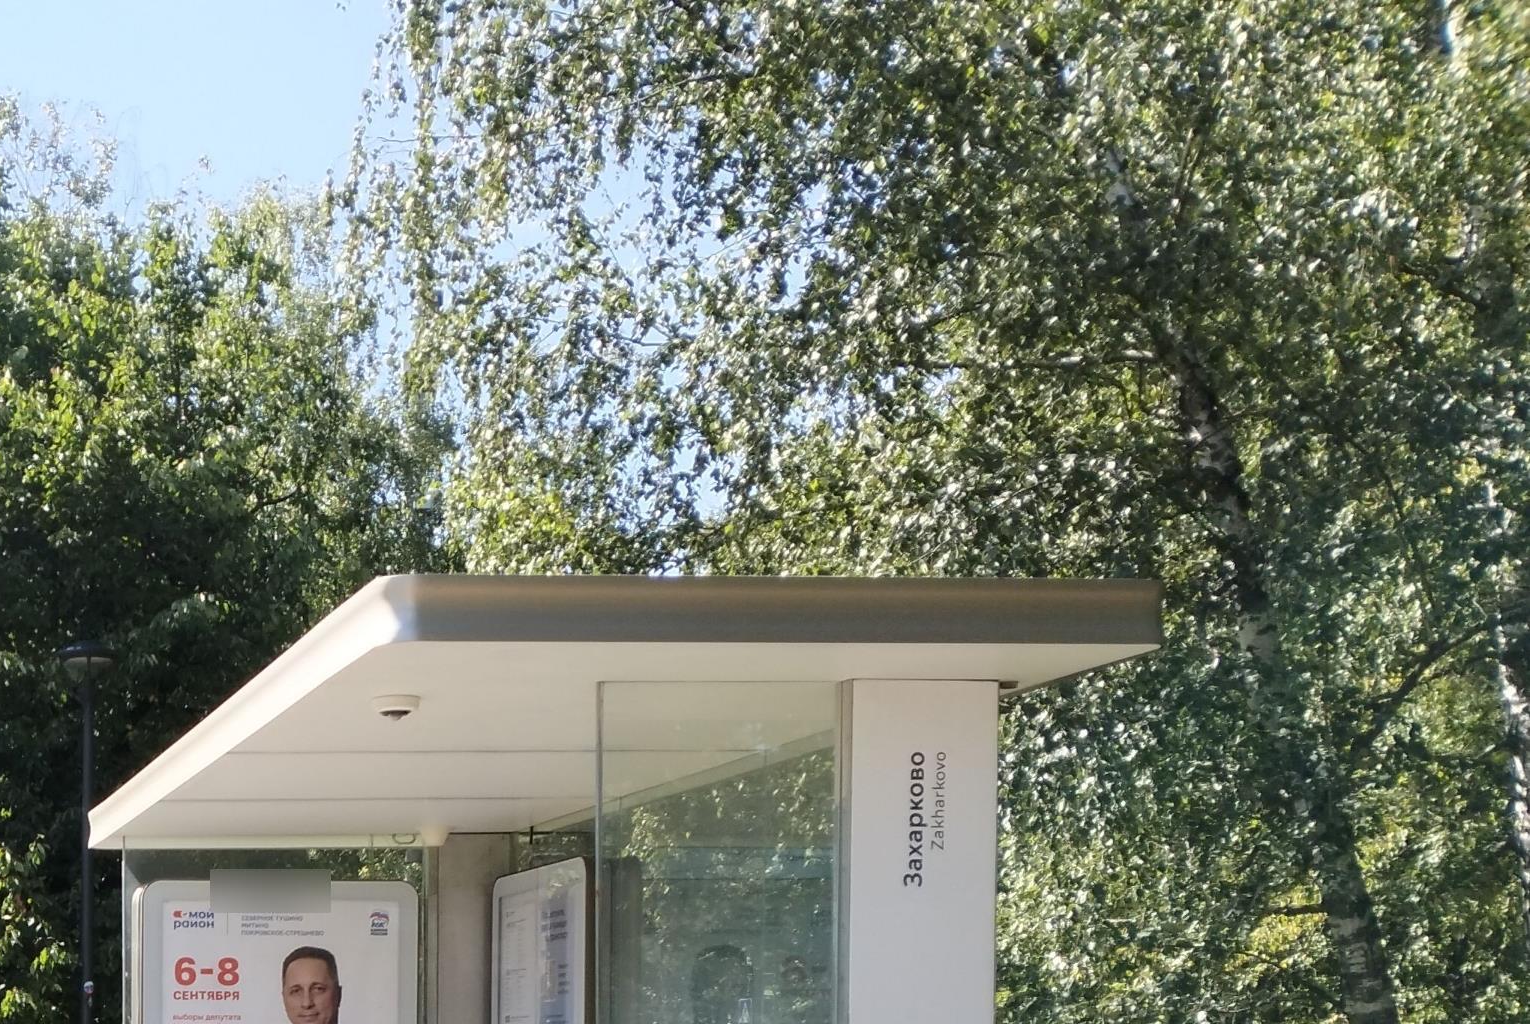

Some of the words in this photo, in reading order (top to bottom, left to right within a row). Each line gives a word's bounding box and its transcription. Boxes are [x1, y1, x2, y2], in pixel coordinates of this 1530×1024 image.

[930, 751, 947, 851] Zakharkovo
[903, 751, 928, 887] Захарково
[174, 956, 240, 986] 6-8
[173, 990, 240, 1001] СЕНТЯБРЯ
[205, 1014, 241, 1022] депутата
